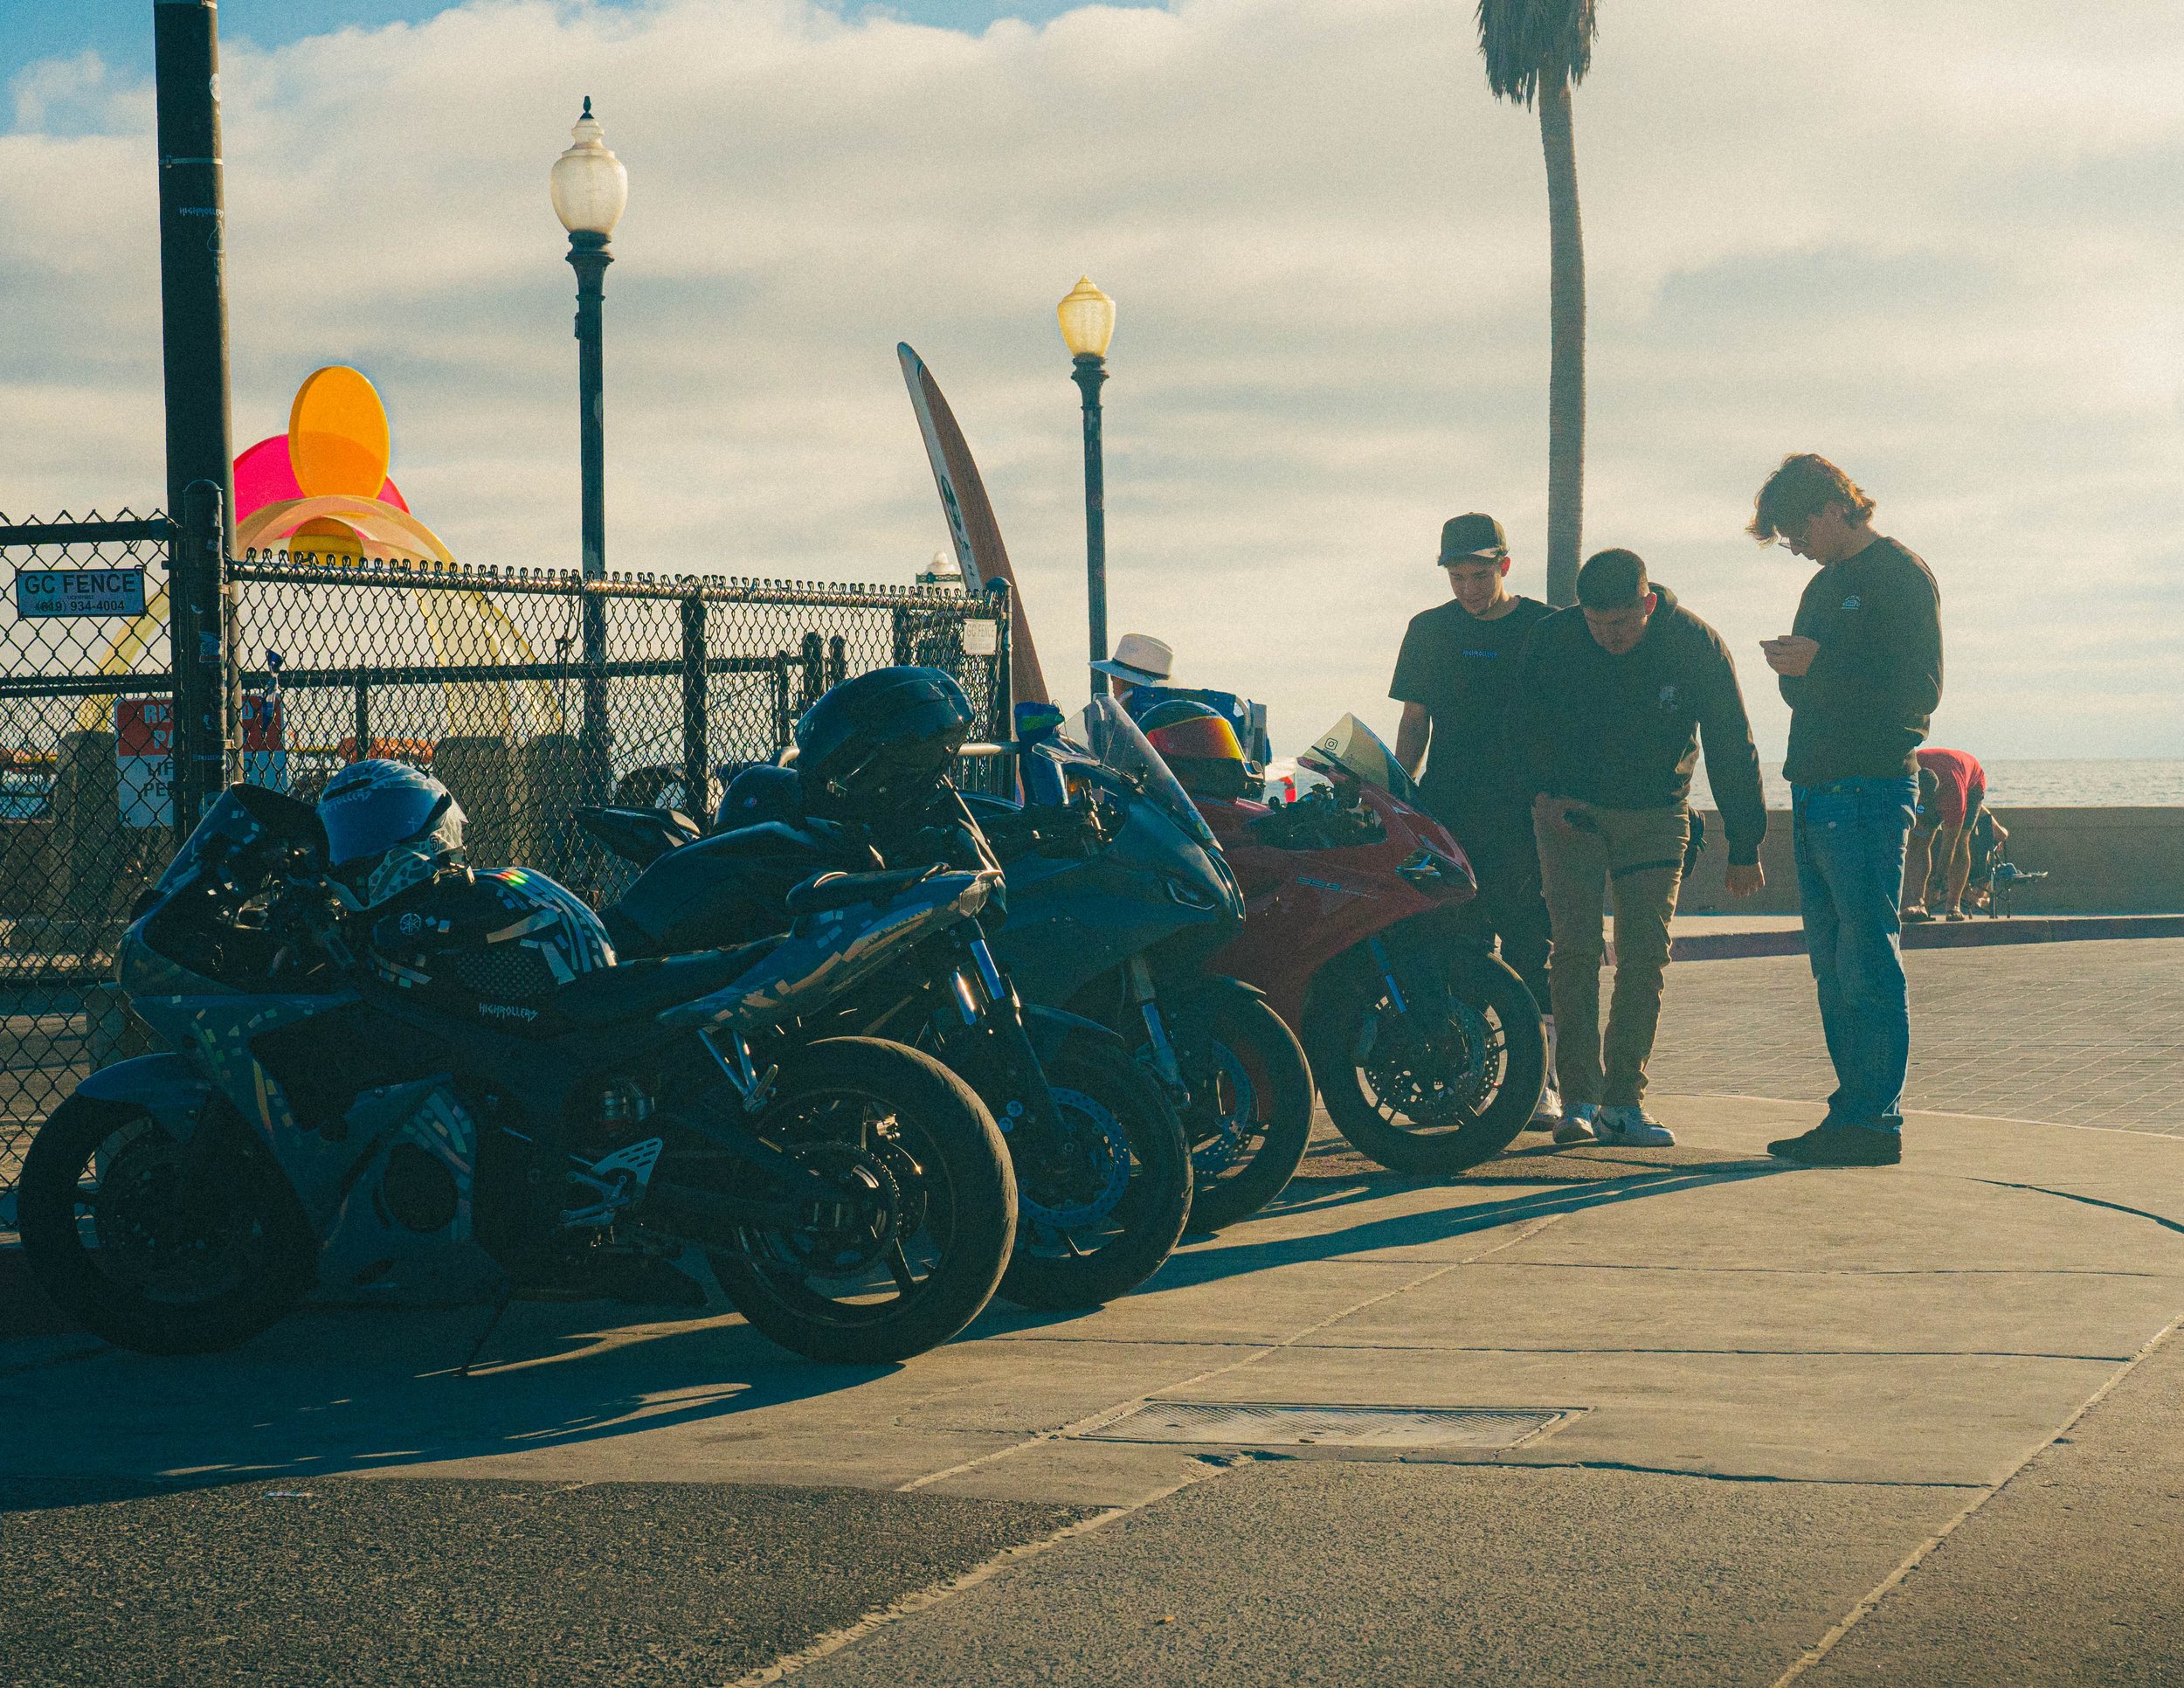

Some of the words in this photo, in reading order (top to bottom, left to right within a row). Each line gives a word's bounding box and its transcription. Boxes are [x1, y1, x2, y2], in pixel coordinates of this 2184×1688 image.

[24, 574, 56, 595] GC
[63, 573, 135, 593] FENCE
[38, 600, 66, 612] (619)
[71, 601, 124, 612] 934-4004
[966, 624, 977, 637] GC
